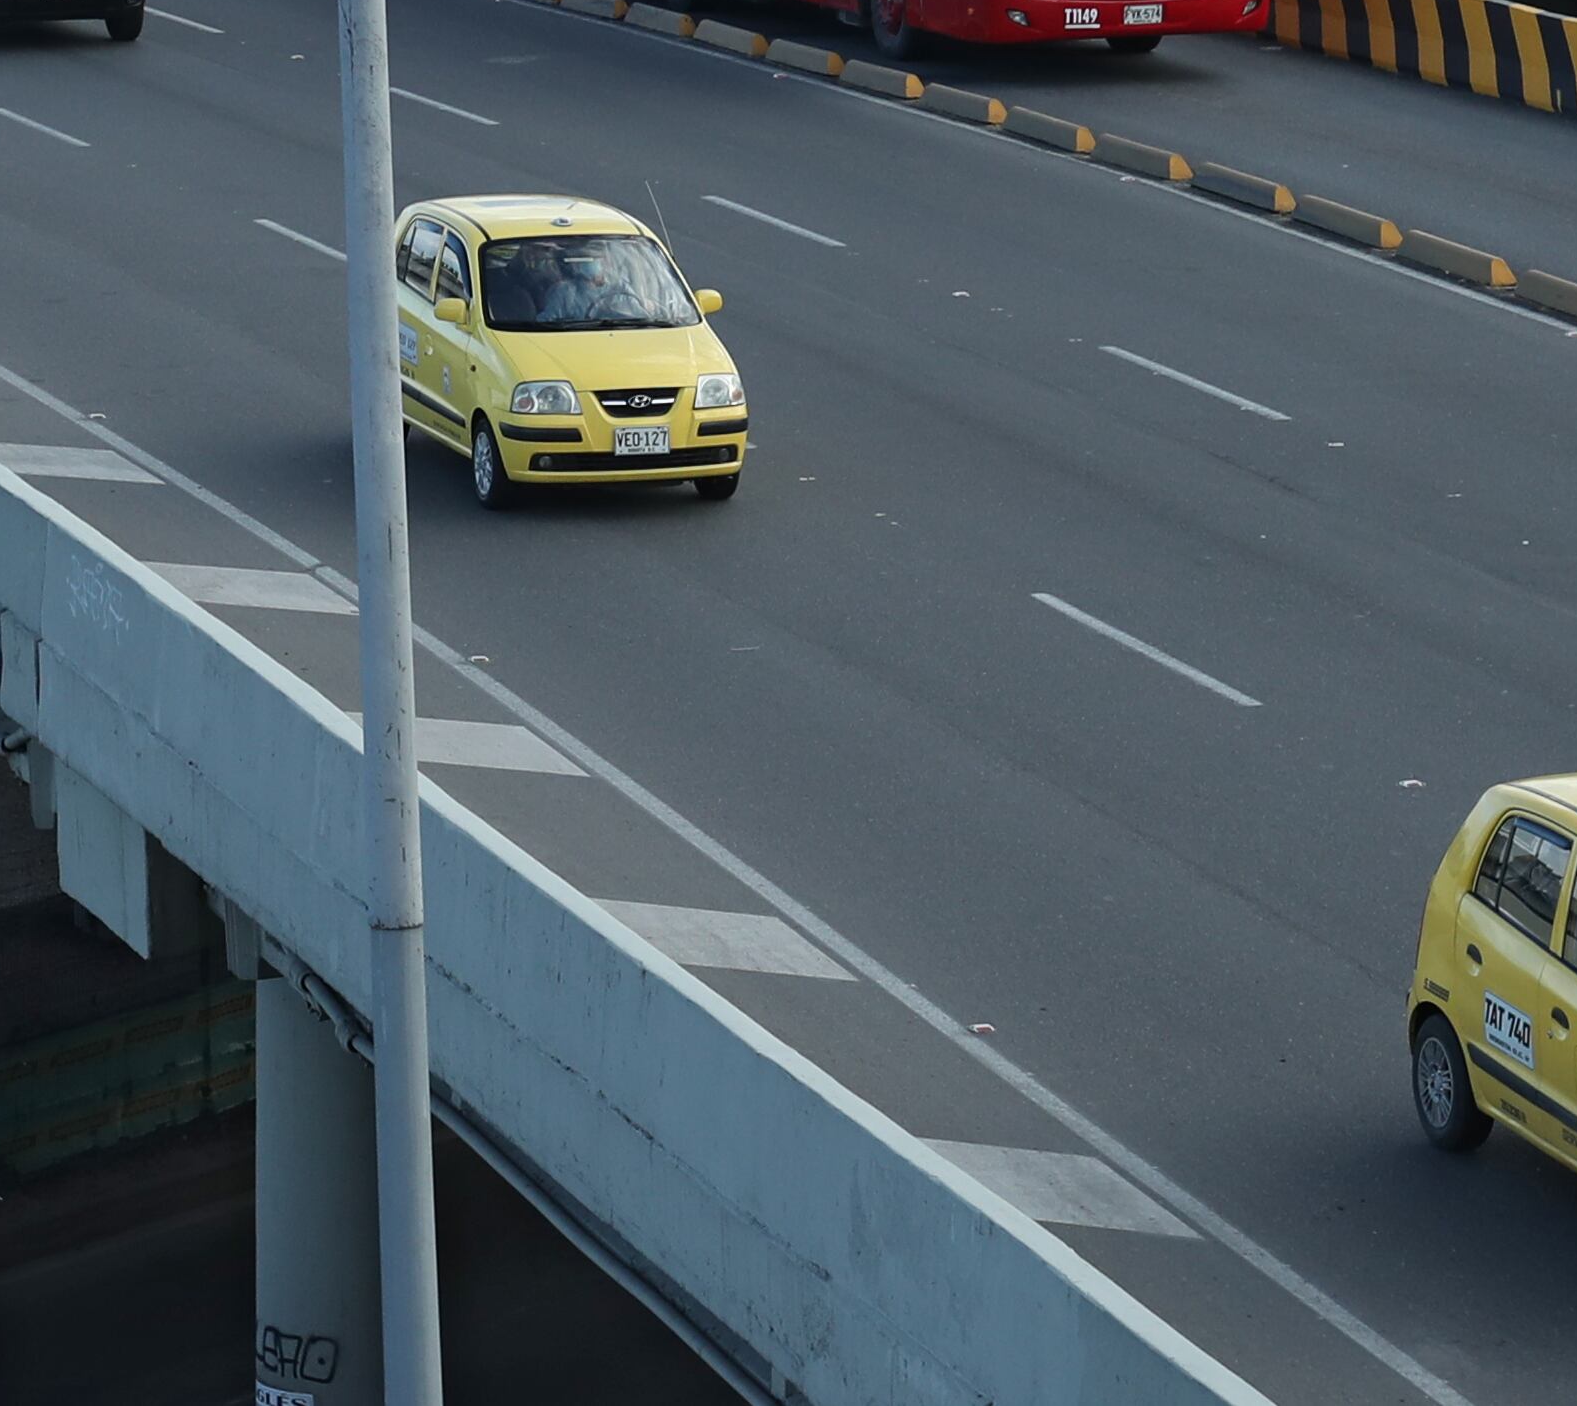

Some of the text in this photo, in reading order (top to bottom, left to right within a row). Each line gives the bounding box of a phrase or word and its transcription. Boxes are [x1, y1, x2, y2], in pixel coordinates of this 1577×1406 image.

[1064, 8, 1099, 24] T1149
[1485, 998, 1532, 1049] TAT 740
